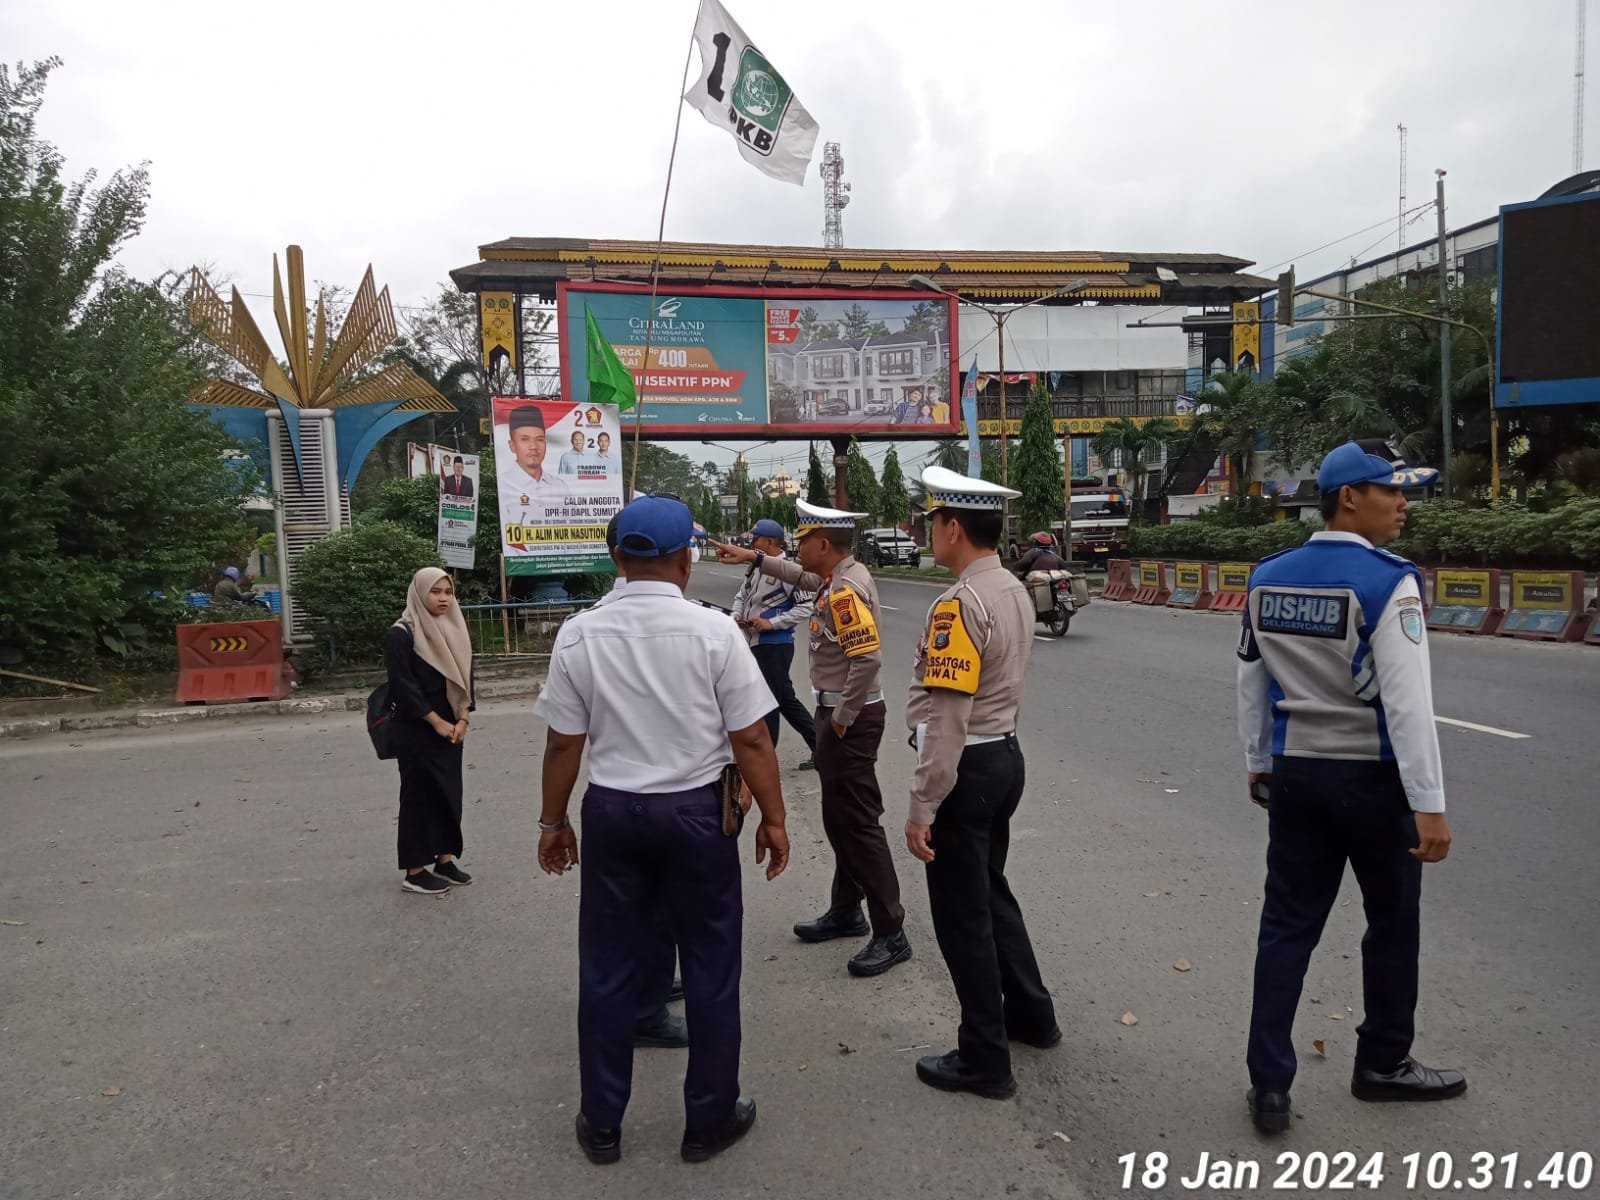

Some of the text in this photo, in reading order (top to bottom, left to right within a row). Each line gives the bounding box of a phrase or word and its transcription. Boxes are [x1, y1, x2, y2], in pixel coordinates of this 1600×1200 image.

[613, 348, 642, 357] ARGA
[658, 350, 687, 368] 400
[635, 375, 698, 387] INSENTIF
[574, 410, 583, 427] 2
[587, 438, 595, 449] 2
[564, 496, 620, 506] CALON ANGGOTA
[545, 508, 570, 518] DPR-RI
[571, 508, 592, 517] DAPIL
[593, 507, 617, 516] SUMUT
[507, 526, 521, 542] 10
[535, 528, 552, 541] ALIM
[554, 527, 569, 540] NUR
[570, 527, 606, 540] NASUTION
[1261, 595, 1341, 625] DISHUB
